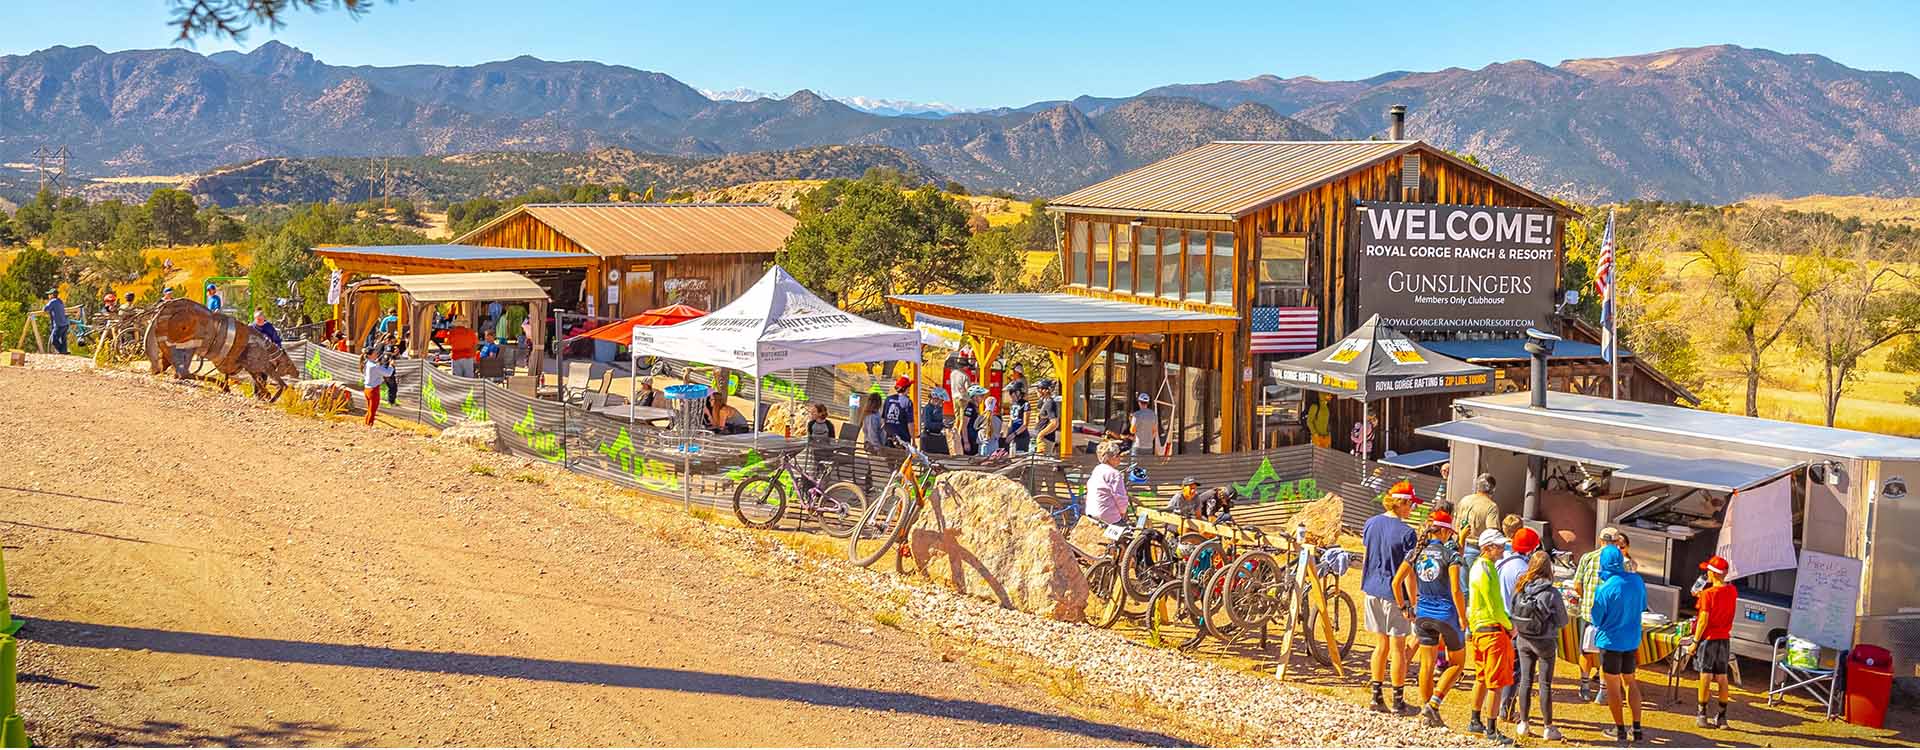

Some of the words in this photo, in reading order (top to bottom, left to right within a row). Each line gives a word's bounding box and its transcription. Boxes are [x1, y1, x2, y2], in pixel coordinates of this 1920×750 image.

[1368, 208, 1553, 245] WELCOME!
[1366, 245, 1406, 257] ROYAL
[1409, 246, 1451, 258] GORGE
[1455, 247, 1495, 259] RANCH
[1498, 248, 1506, 259] &
[1508, 249, 1553, 260] RESORT
[1388, 271, 1532, 294] GUNSLINGERS
[1414, 295, 1449, 304] Members
[1450, 296, 1466, 306] Only
[1468, 296, 1505, 304] Clubhouse
[702, 317, 764, 329] WHITEWATER
[776, 314, 852, 329] WHITEWATER
[1375, 381, 1394, 391] ROYAL
[1394, 379, 1413, 390] GORGE
[1414, 376, 1438, 388] RAFTING
[1445, 376, 1455, 387] ZIP
[1456, 376, 1468, 385] LINE
[1469, 374, 1487, 385] TOURS
